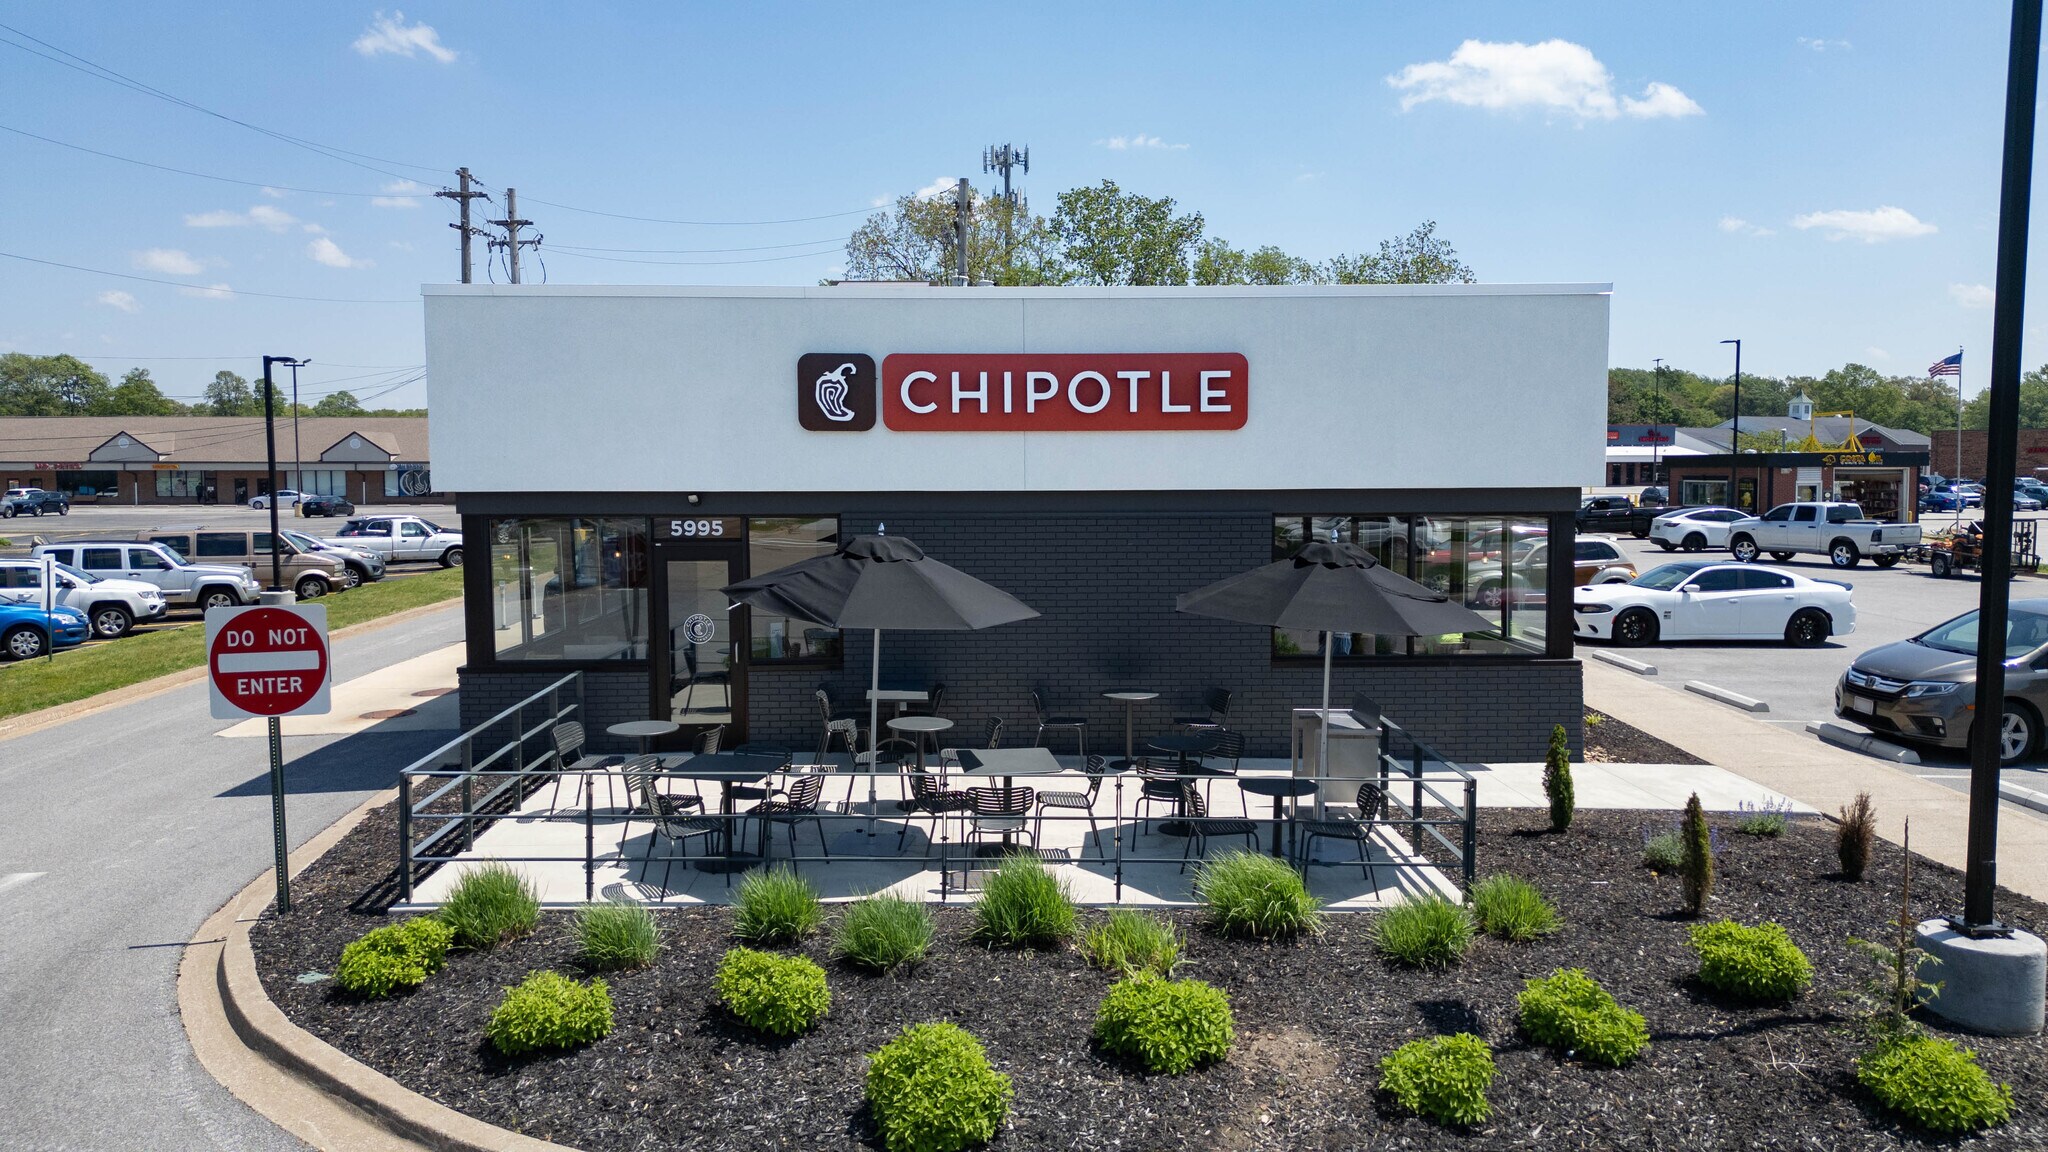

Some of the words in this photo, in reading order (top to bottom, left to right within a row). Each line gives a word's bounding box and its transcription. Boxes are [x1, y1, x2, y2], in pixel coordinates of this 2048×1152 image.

[900, 370, 1232, 413] CHIPOTLE
[671, 520, 723, 536] 5995
[227, 630, 254, 647] DO
[268, 628, 308, 645] NOT
[237, 677, 302, 695] ENTER
